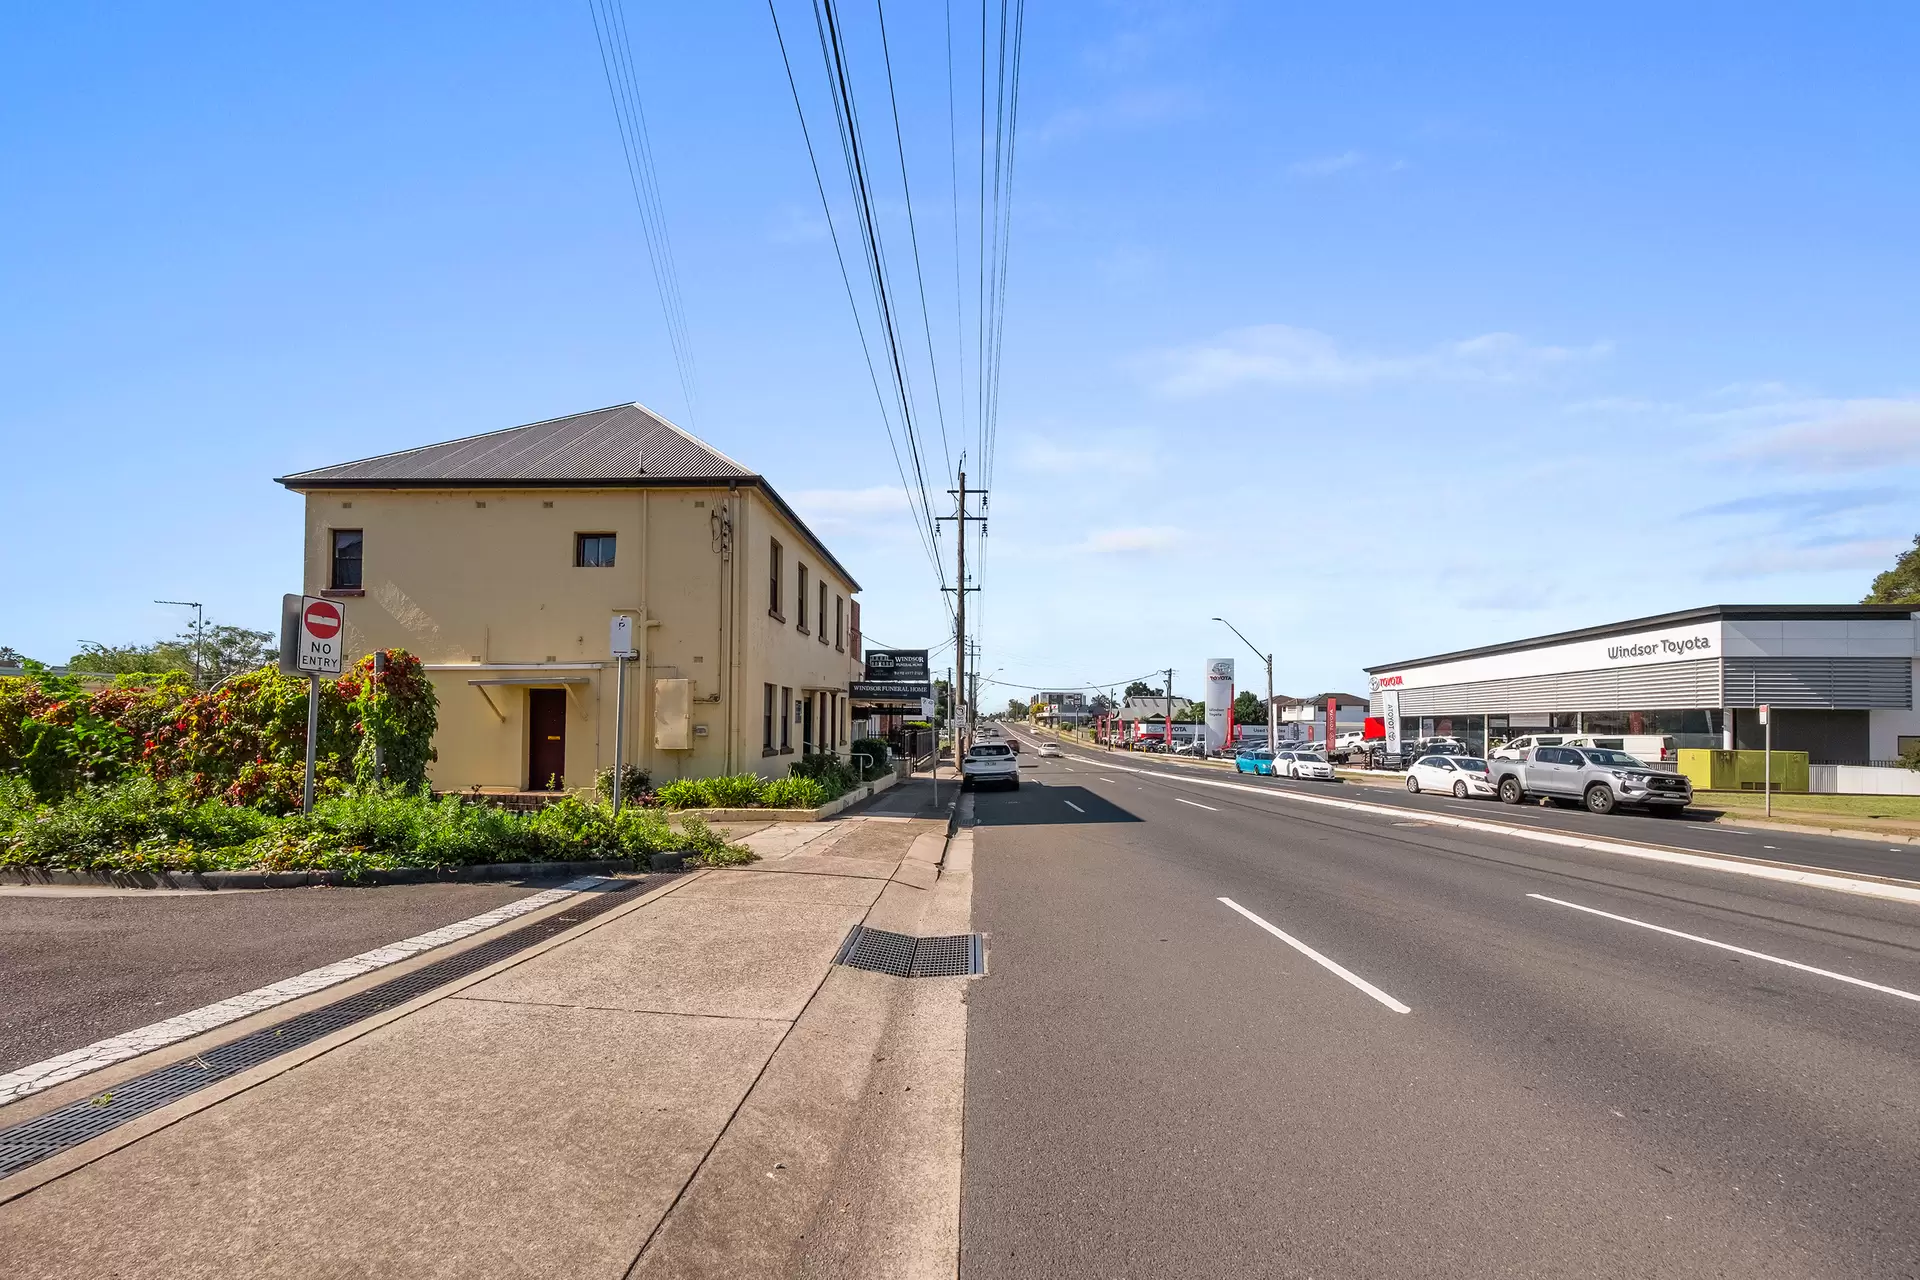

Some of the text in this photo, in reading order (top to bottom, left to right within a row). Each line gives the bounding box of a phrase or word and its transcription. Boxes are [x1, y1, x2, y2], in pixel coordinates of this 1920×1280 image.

[311, 642, 332, 655] NO
[1608, 636, 1711, 659] Windsor Toyota
[302, 655, 338, 668] ENTRY
[1380, 675, 1403, 688] TOYOTA
[1387, 704, 1395, 730] TOYOTA
